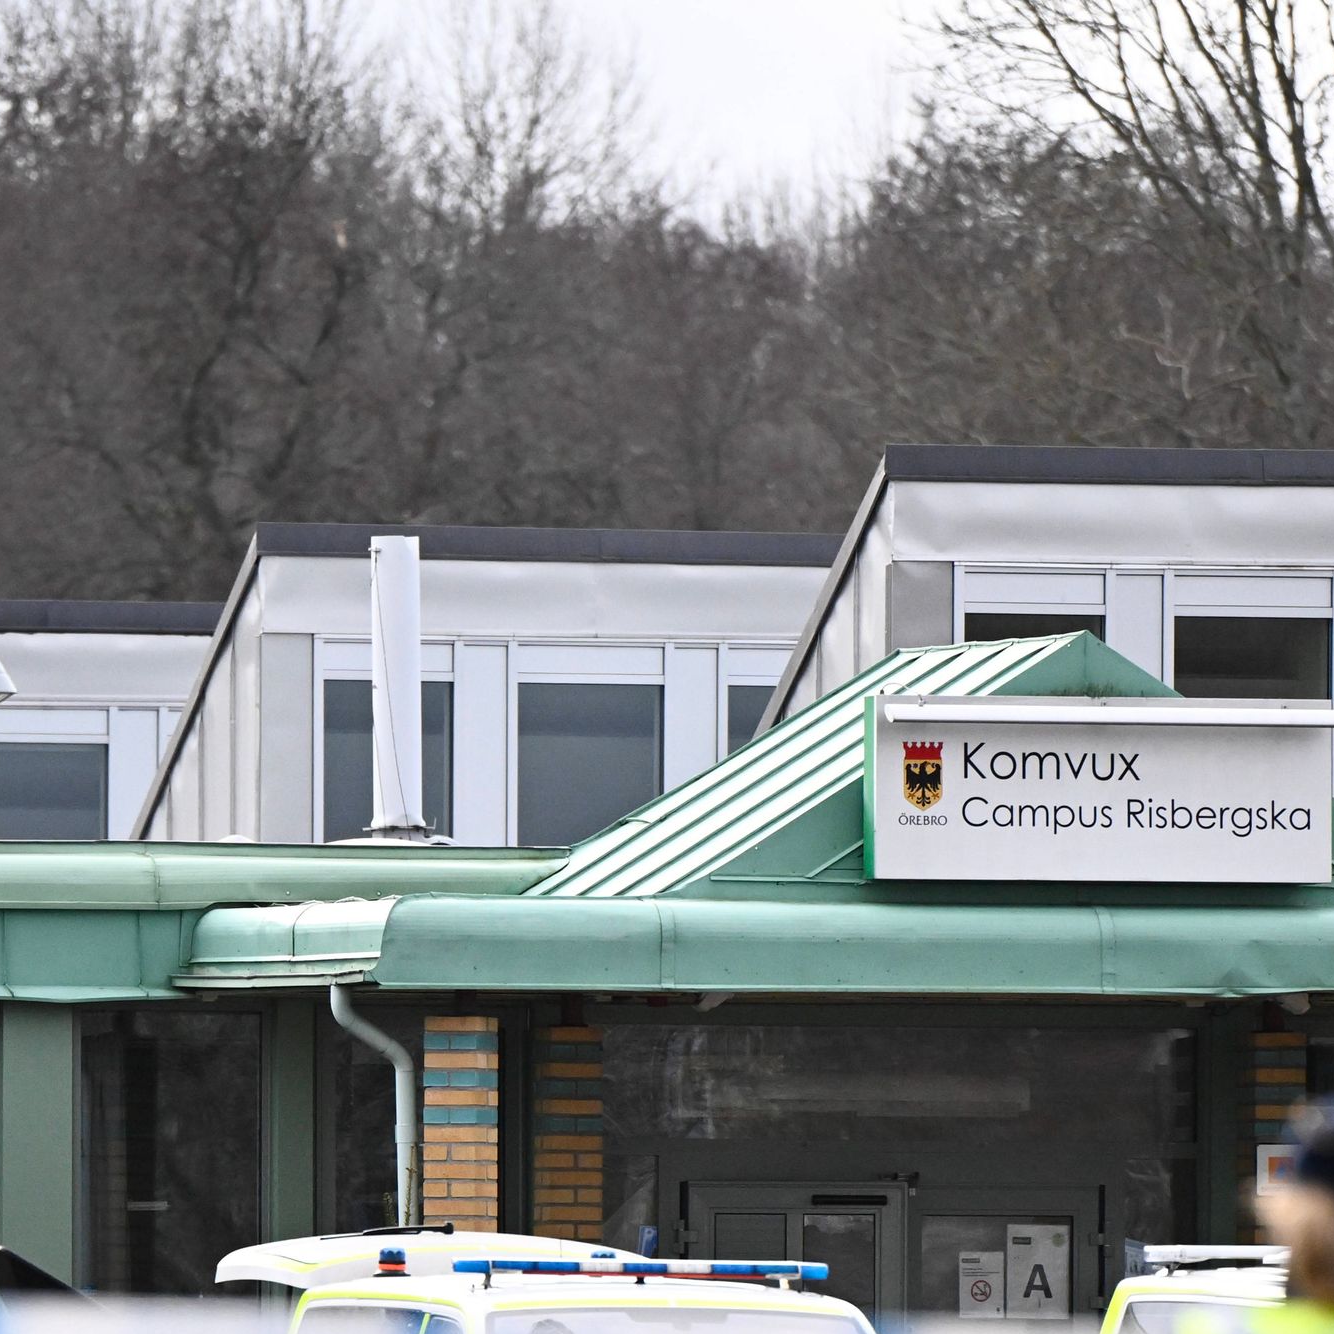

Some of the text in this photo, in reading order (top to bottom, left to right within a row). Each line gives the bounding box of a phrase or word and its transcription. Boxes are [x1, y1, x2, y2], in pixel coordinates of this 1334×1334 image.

[963, 741, 1141, 782] Komvux
[898, 812, 948, 827] ÖREBRO
[961, 796, 1312, 838] Campus Risbergska
[1022, 1263, 1054, 1299] A
